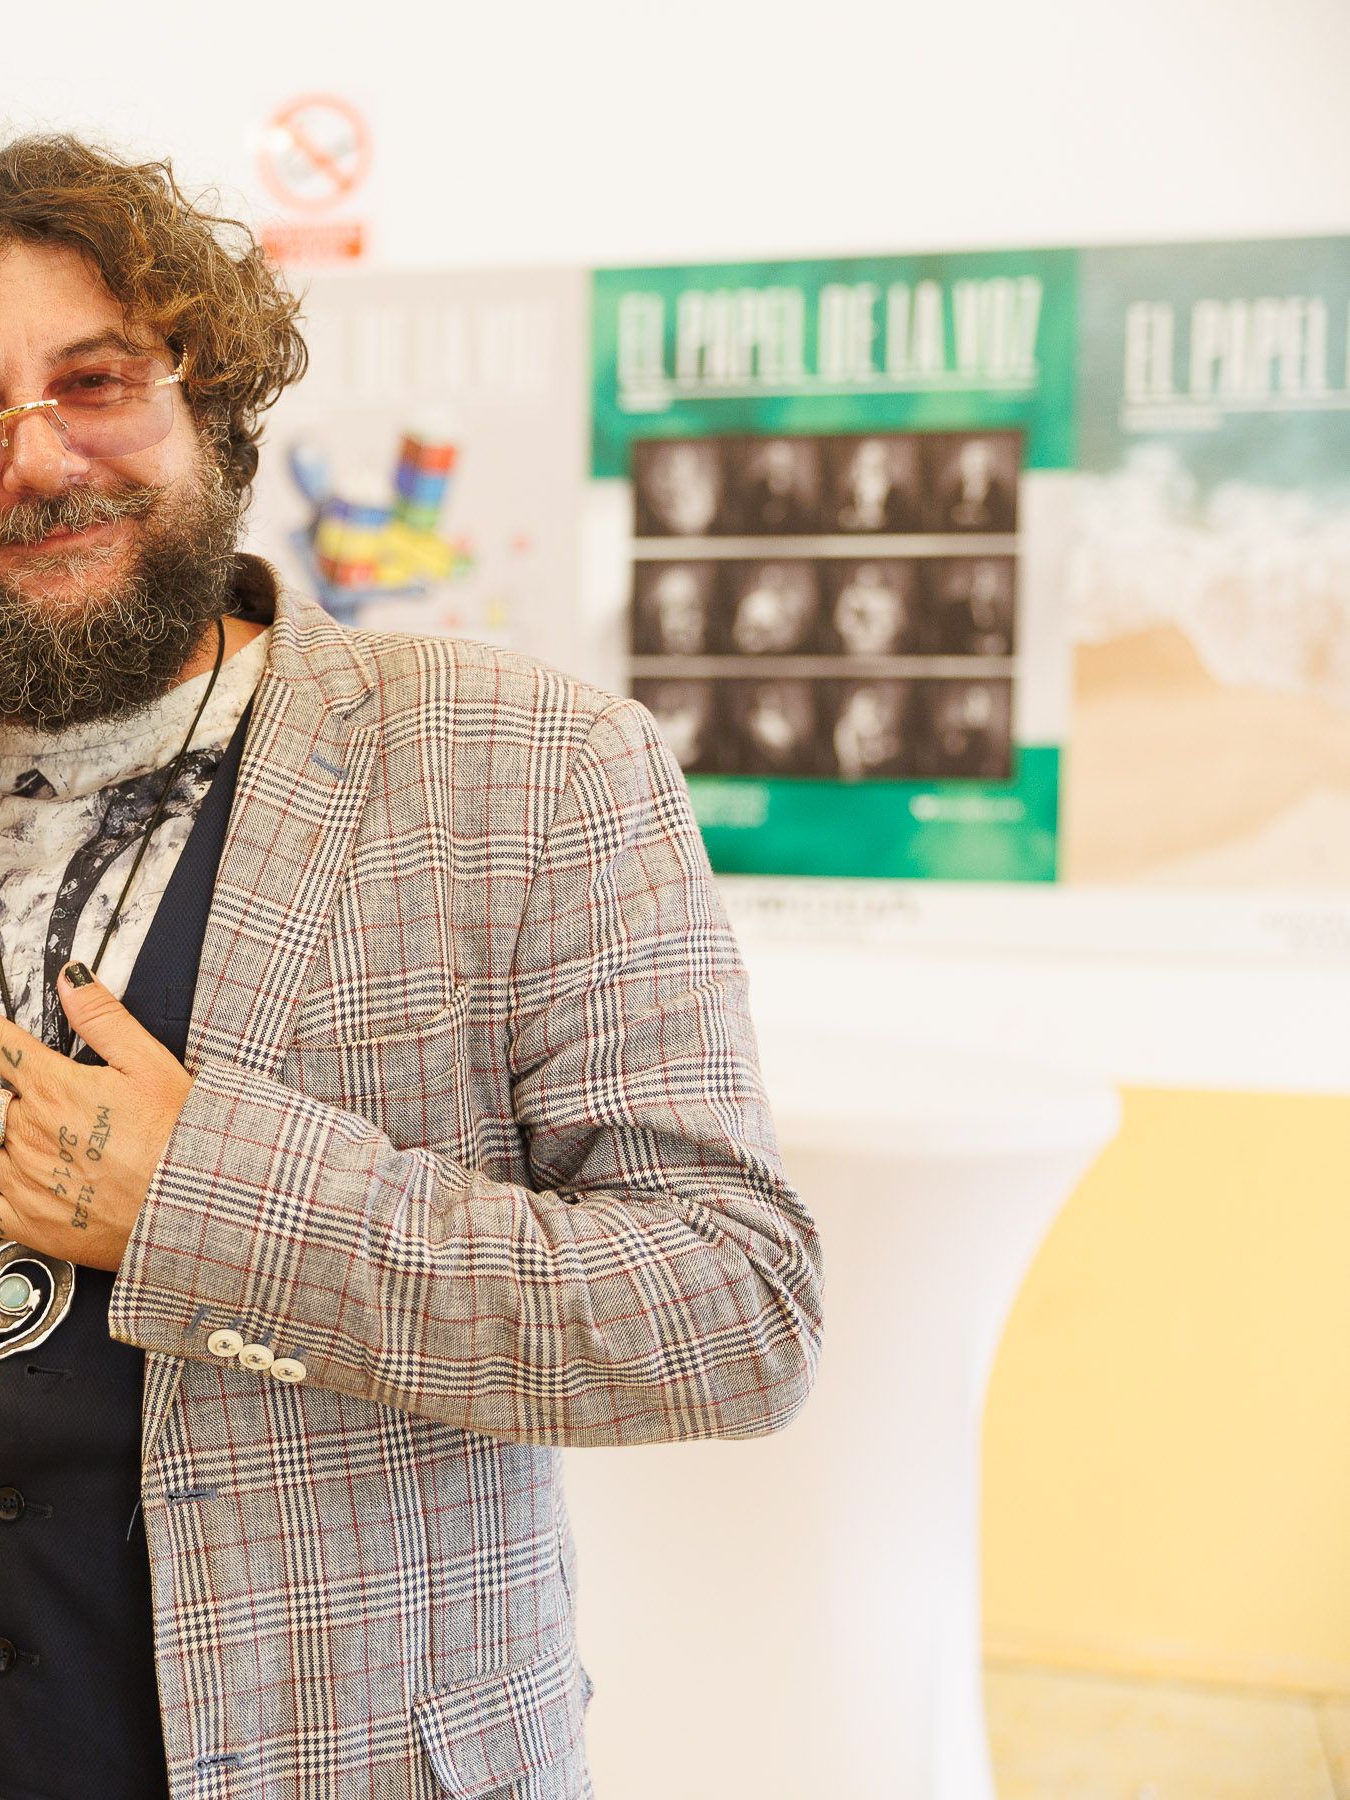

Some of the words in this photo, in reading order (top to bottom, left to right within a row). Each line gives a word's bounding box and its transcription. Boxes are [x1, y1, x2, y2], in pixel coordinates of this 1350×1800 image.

[618, 290, 670, 388] EL
[676, 285, 810, 386] PAPEL
[817, 281, 884, 384] DE
[887, 278, 948, 382] LA
[952, 274, 1044, 382] VOZ
[1125, 300, 1180, 400] EL
[1190, 295, 1334, 400] PAPEL
[48, 1125, 78, 1196] 2014
[86, 1104, 111, 1162] MATEO
